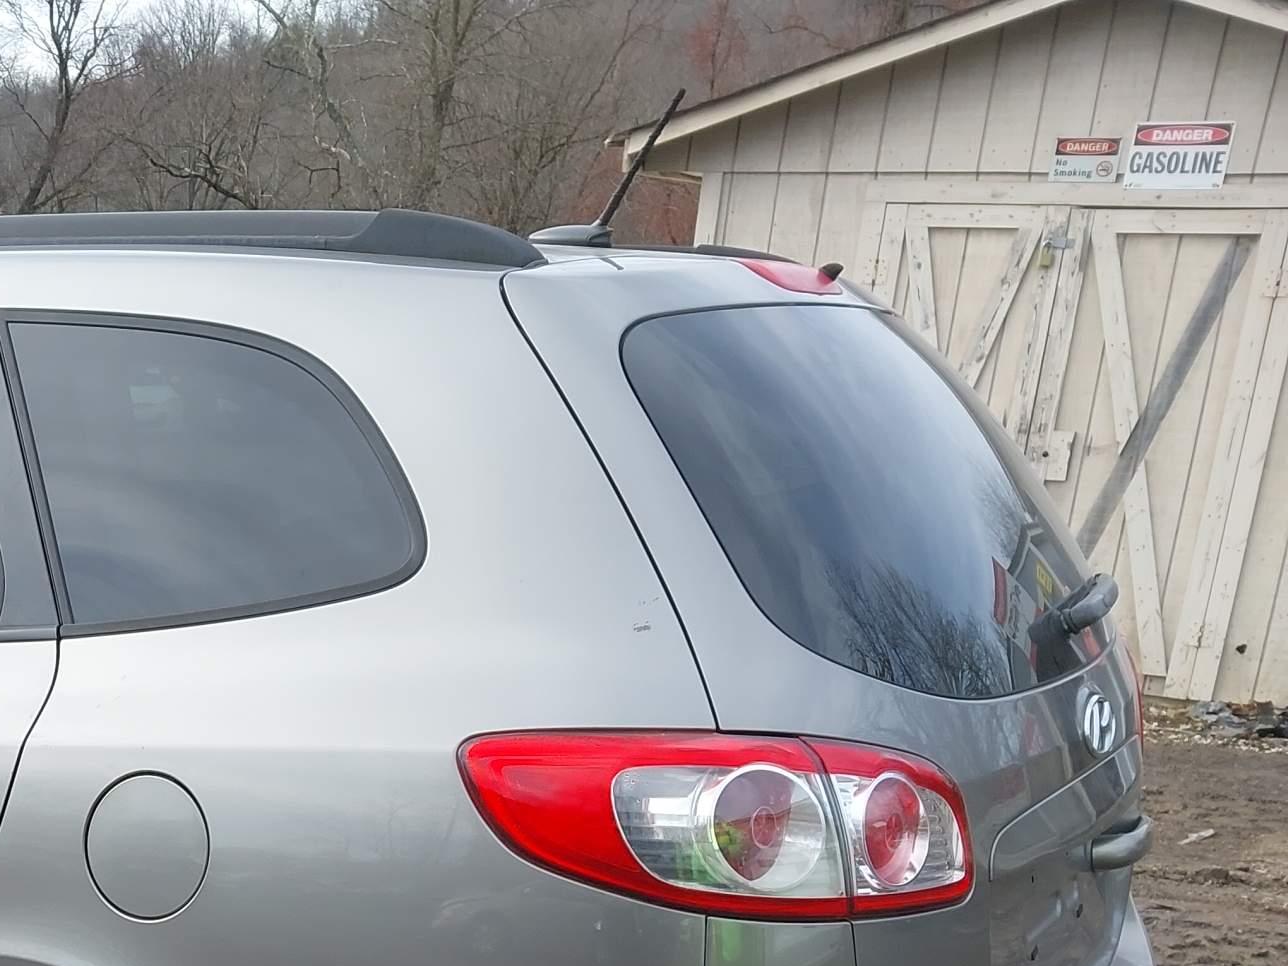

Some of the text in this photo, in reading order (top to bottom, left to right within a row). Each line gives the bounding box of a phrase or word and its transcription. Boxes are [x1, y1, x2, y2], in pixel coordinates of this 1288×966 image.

[1151, 129, 1214, 142] DANGER
[1066, 142, 1109, 152] DANGER
[1055, 159, 1068, 167] No
[1129, 151, 1227, 174] GASOLINE
[1053, 168, 1093, 178] Smoking
